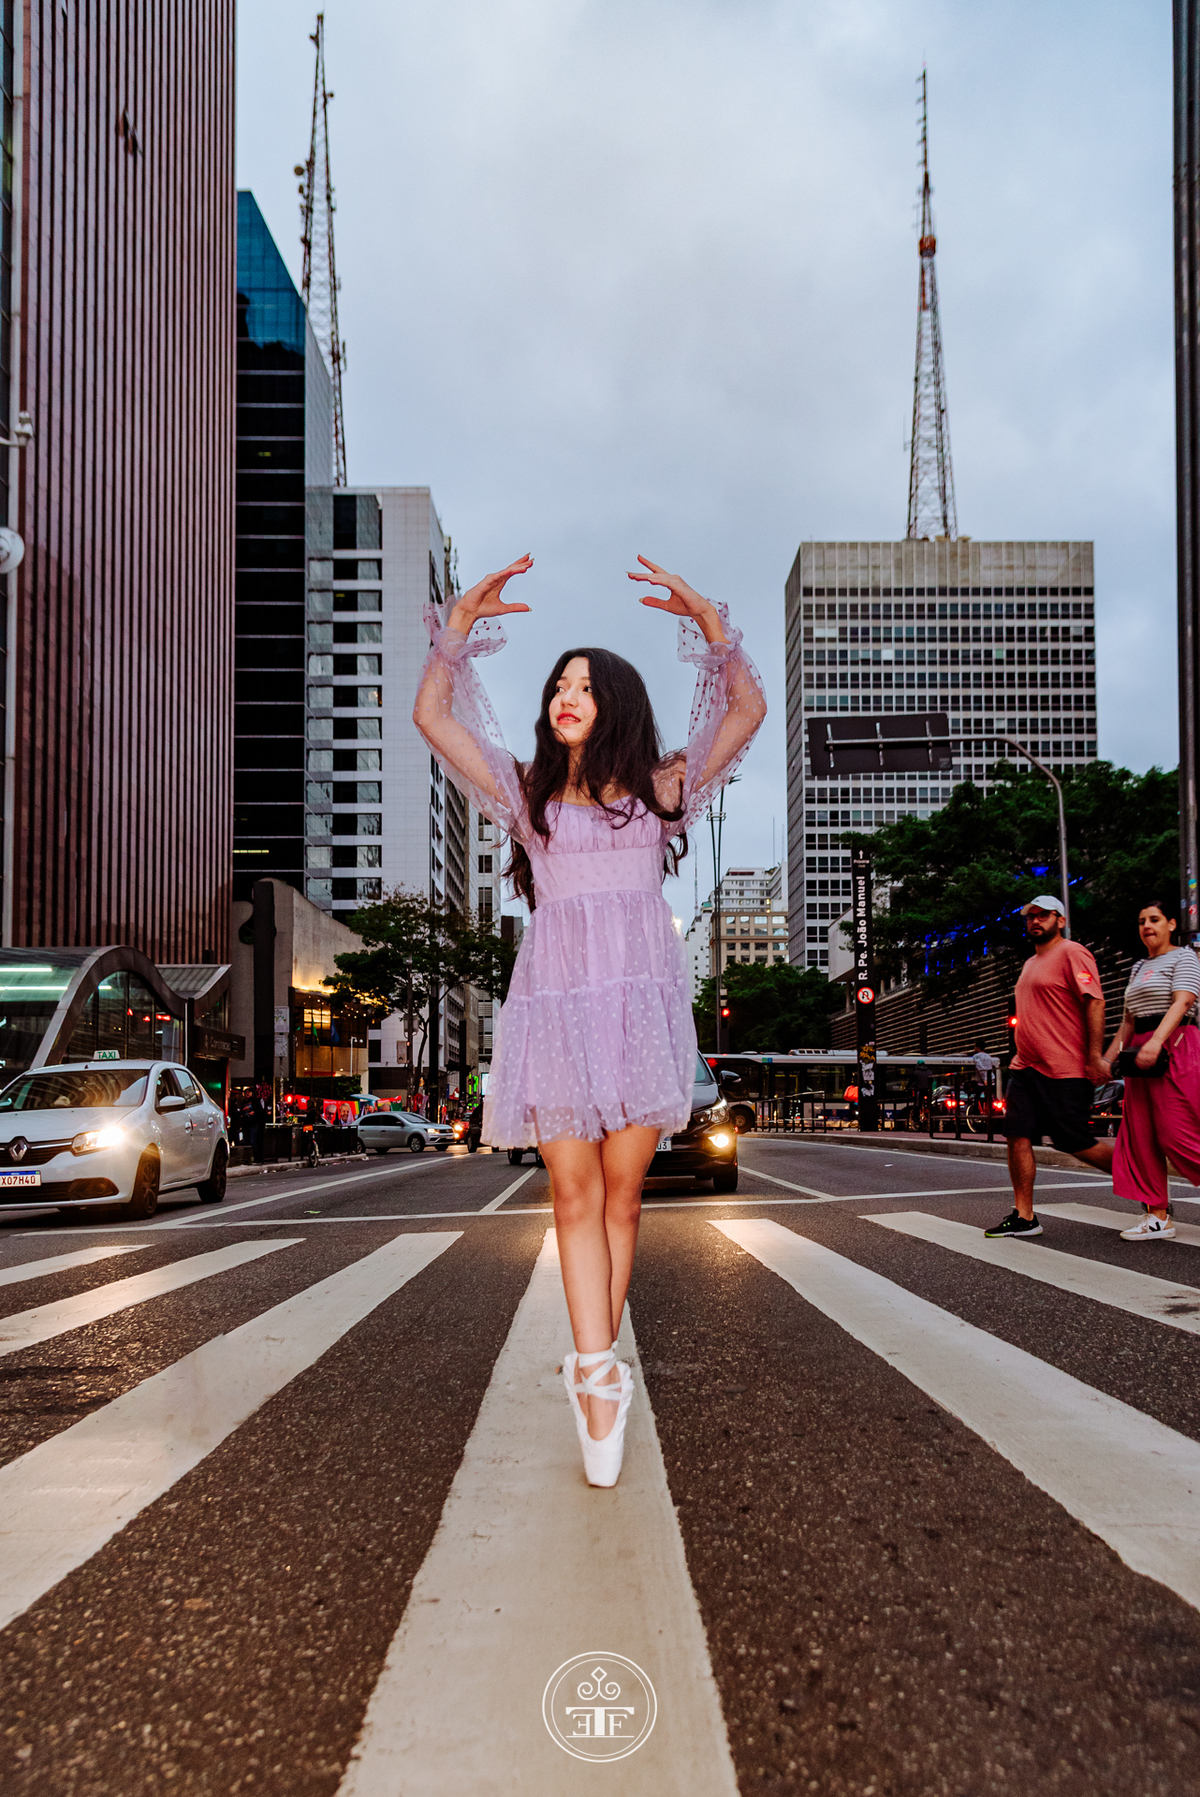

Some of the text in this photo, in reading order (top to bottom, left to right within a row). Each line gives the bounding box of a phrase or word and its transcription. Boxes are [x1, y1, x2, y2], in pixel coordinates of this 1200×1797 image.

[855, 876, 868, 980] R. Pe. João Manuel
[97, 1051, 116, 1059] TAXI
